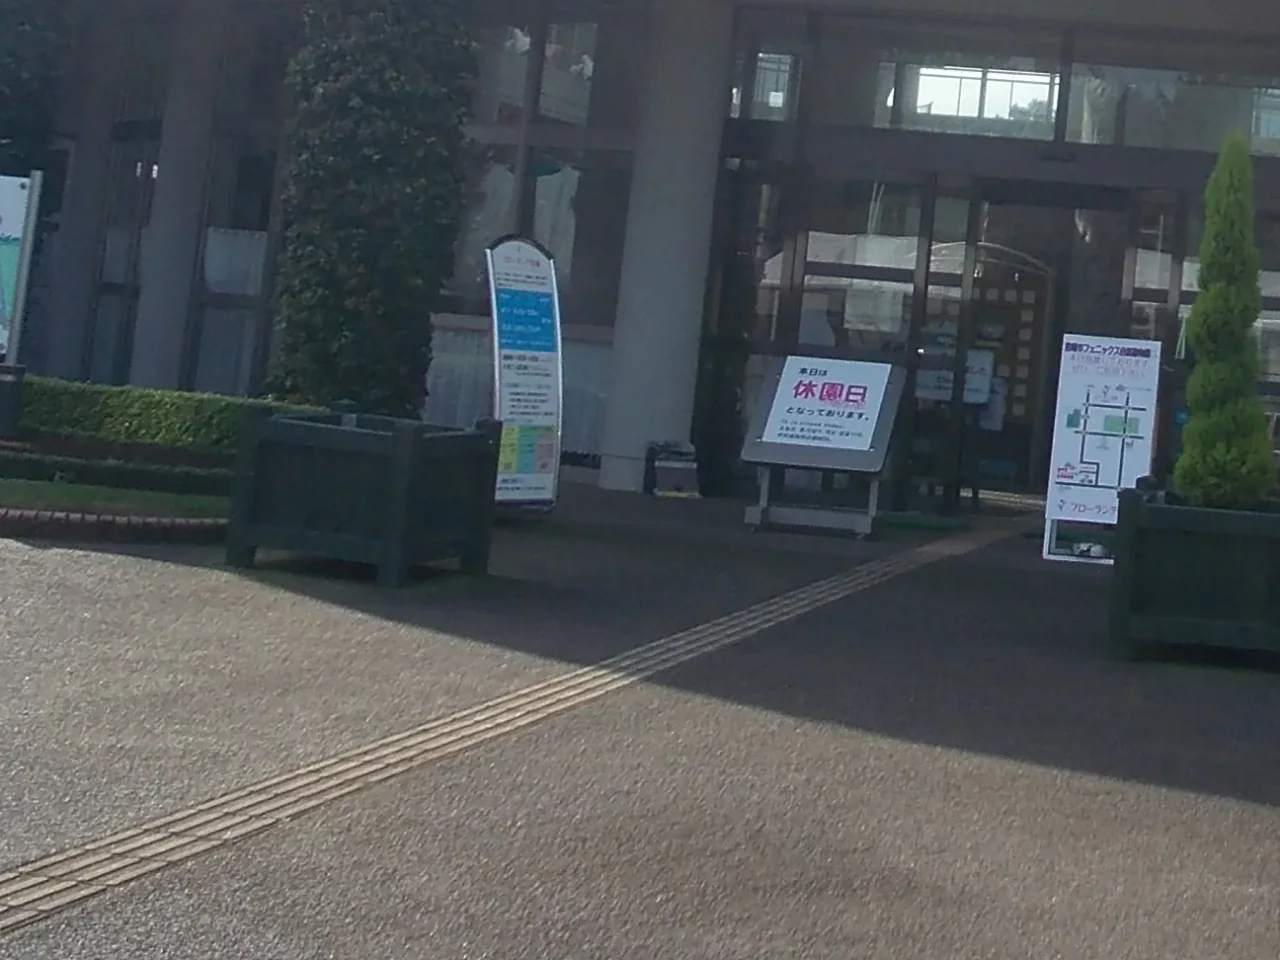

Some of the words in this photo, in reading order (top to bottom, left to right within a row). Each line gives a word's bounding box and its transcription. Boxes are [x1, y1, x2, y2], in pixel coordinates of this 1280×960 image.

[798, 367, 828, 377] 本日は
[793, 380, 868, 404] 休園日
[786, 406, 869, 421] となっております。
